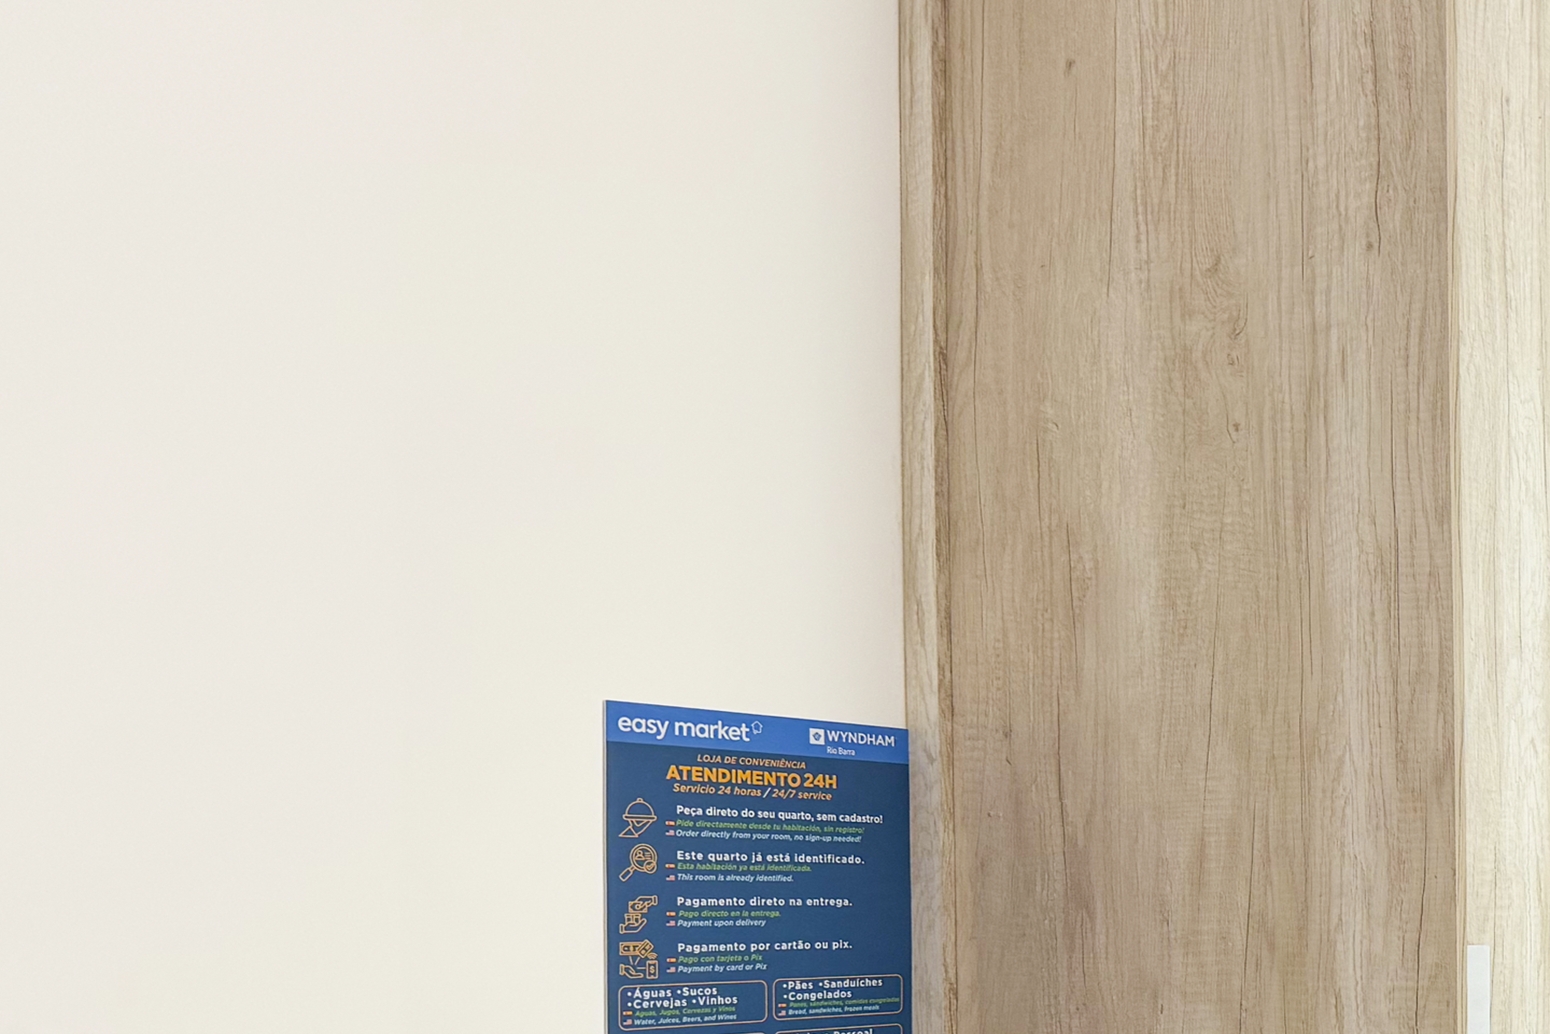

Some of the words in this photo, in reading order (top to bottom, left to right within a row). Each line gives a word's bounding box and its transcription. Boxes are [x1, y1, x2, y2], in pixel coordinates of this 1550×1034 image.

[617, 716, 669, 740] easy
[674, 720, 750, 742] market
[826, 729, 895, 747] WYNDHAM
[826, 745, 838, 755] Rio
[838, 746, 855, 756] Barra
[697, 754, 722, 763] LOJA
[724, 756, 737, 765] DE
[739, 756, 806, 769] CONVENIÊNCIA
[665, 764, 802, 788] ATENDIMENTO
[803, 772, 838, 789] 24H
[673, 783, 715, 795] Servicio
[717, 785, 731, 795] 24
[733, 786, 762, 797] horas
[772, 789, 796, 799] 24/7
[798, 790, 832, 800] service
[676, 805, 703, 817] Peça
[705, 806, 739, 817] direto
[741, 808, 755, 818] do
[757, 811, 775, 819] seu
[778, 811, 814, 821] quarto,
[816, 813, 836, 822] sem
[838, 814, 883, 824] cadastro!
[676, 819, 694, 827] Pide
[696, 820, 747, 829] directamente
[749, 822, 771, 830] desde
[676, 830, 699, 838] Order
[701, 830, 731, 839] directly
[732, 832, 751, 841] from
[805, 834, 832, 843] sign-up
[676, 851, 704, 861] Este
[707, 853, 748, 863] quarto
[751, 852, 763, 863] já
[766, 853, 791, 862] está
[794, 853, 865, 865] identificado.
[677, 873, 693, 882] This
[694, 874, 716, 882] room
[717, 874, 724, 882] is
[725, 874, 754, 883] already
[755, 874, 794, 882] identified.
[677, 896, 746, 908] Pagamento
[749, 896, 786, 907] direto
[789, 898, 803, 906] na
[806, 897, 853, 908] entrega.
[678, 910, 700, 919] Pago
[677, 920, 713, 928] Payment
[713, 920, 734, 928] upon
[735, 918, 767, 927] delivery
[677, 943, 747, 954] Pagamento
[750, 943, 771, 953] por
[774, 940, 811, 951] cartão
[814, 942, 829, 950] ou
[832, 939, 853, 951] pix.
[677, 955, 699, 964] Pago
[750, 953, 763, 961] Pix
[677, 965, 713, 974] Payment
[714, 964, 725, 972] by
[726, 963, 744, 971] card
[755, 962, 768, 971] Pix
[682, 987, 718, 997] Sucos
[788, 990, 853, 1003] Congelados
[633, 998, 688, 1010] Cervejas
[697, 995, 738, 1006] Vinhos
